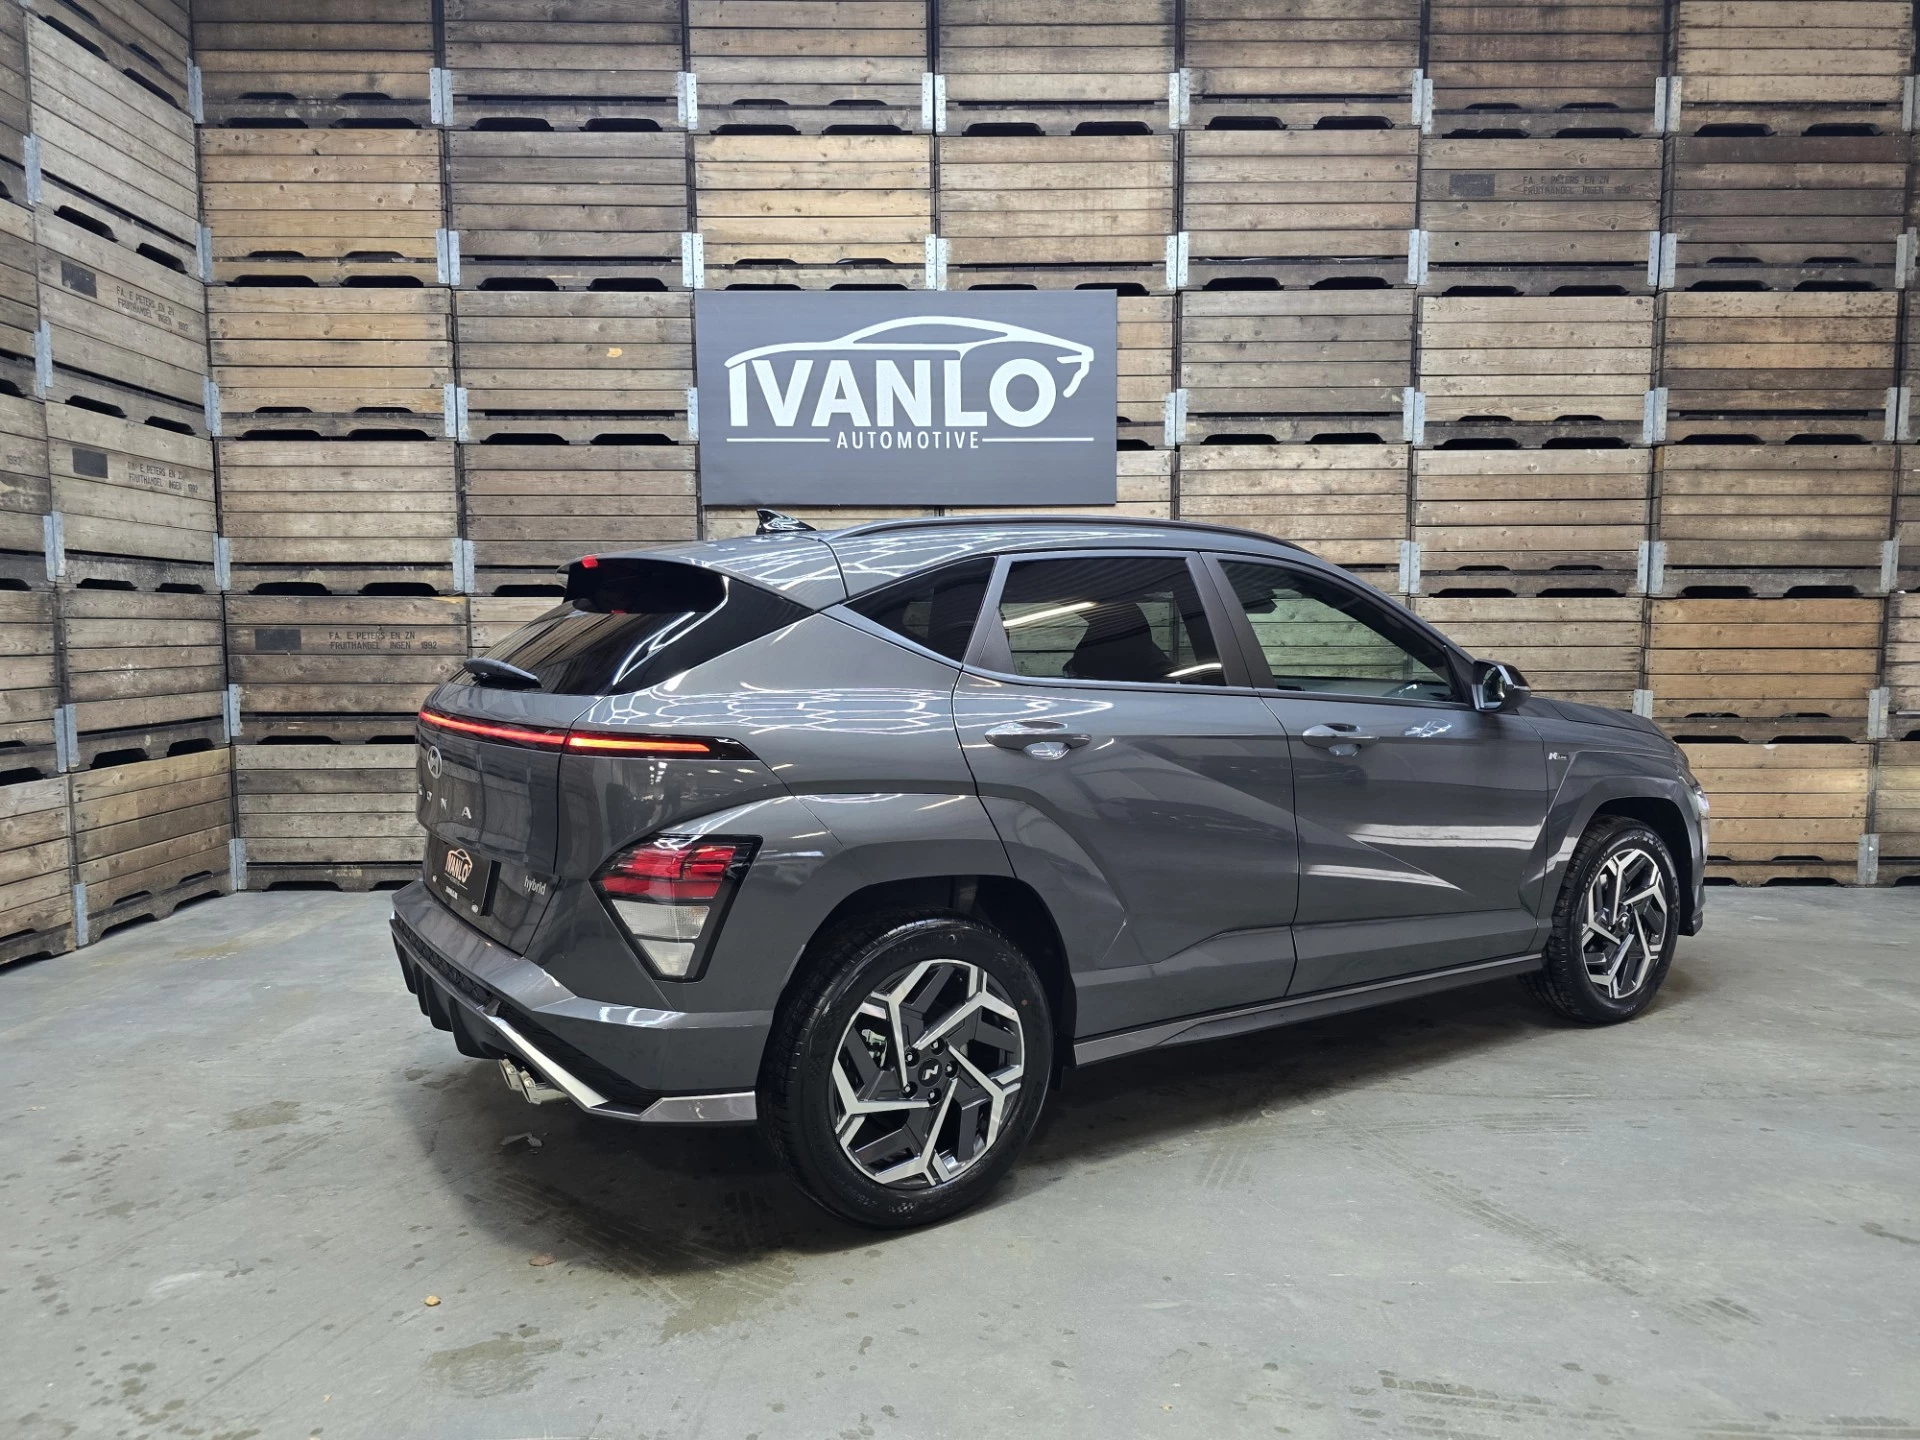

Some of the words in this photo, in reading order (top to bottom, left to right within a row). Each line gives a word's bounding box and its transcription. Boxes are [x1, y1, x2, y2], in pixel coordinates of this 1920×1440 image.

[1584, 176, 1594, 184] EN
[1583, 186, 1604, 194] INGEN
[136, 293, 155, 309] PETERS
[729, 357, 1057, 428] IVANLO
[837, 431, 979, 449] AUTOMOTIVE
[147, 465, 165, 477] PETERS
[169, 469, 175, 479] EN
[357, 631, 385, 640] PETERS
[391, 631, 400, 640] EN
[405, 631, 415, 640] ZN
[330, 641, 380, 650] FRUITHANDEL
[390, 641, 411, 650] INGEN
[421, 641, 437, 650] 1992
[445, 851, 469, 884] IVANLO
[524, 875, 546, 896] hybrid
